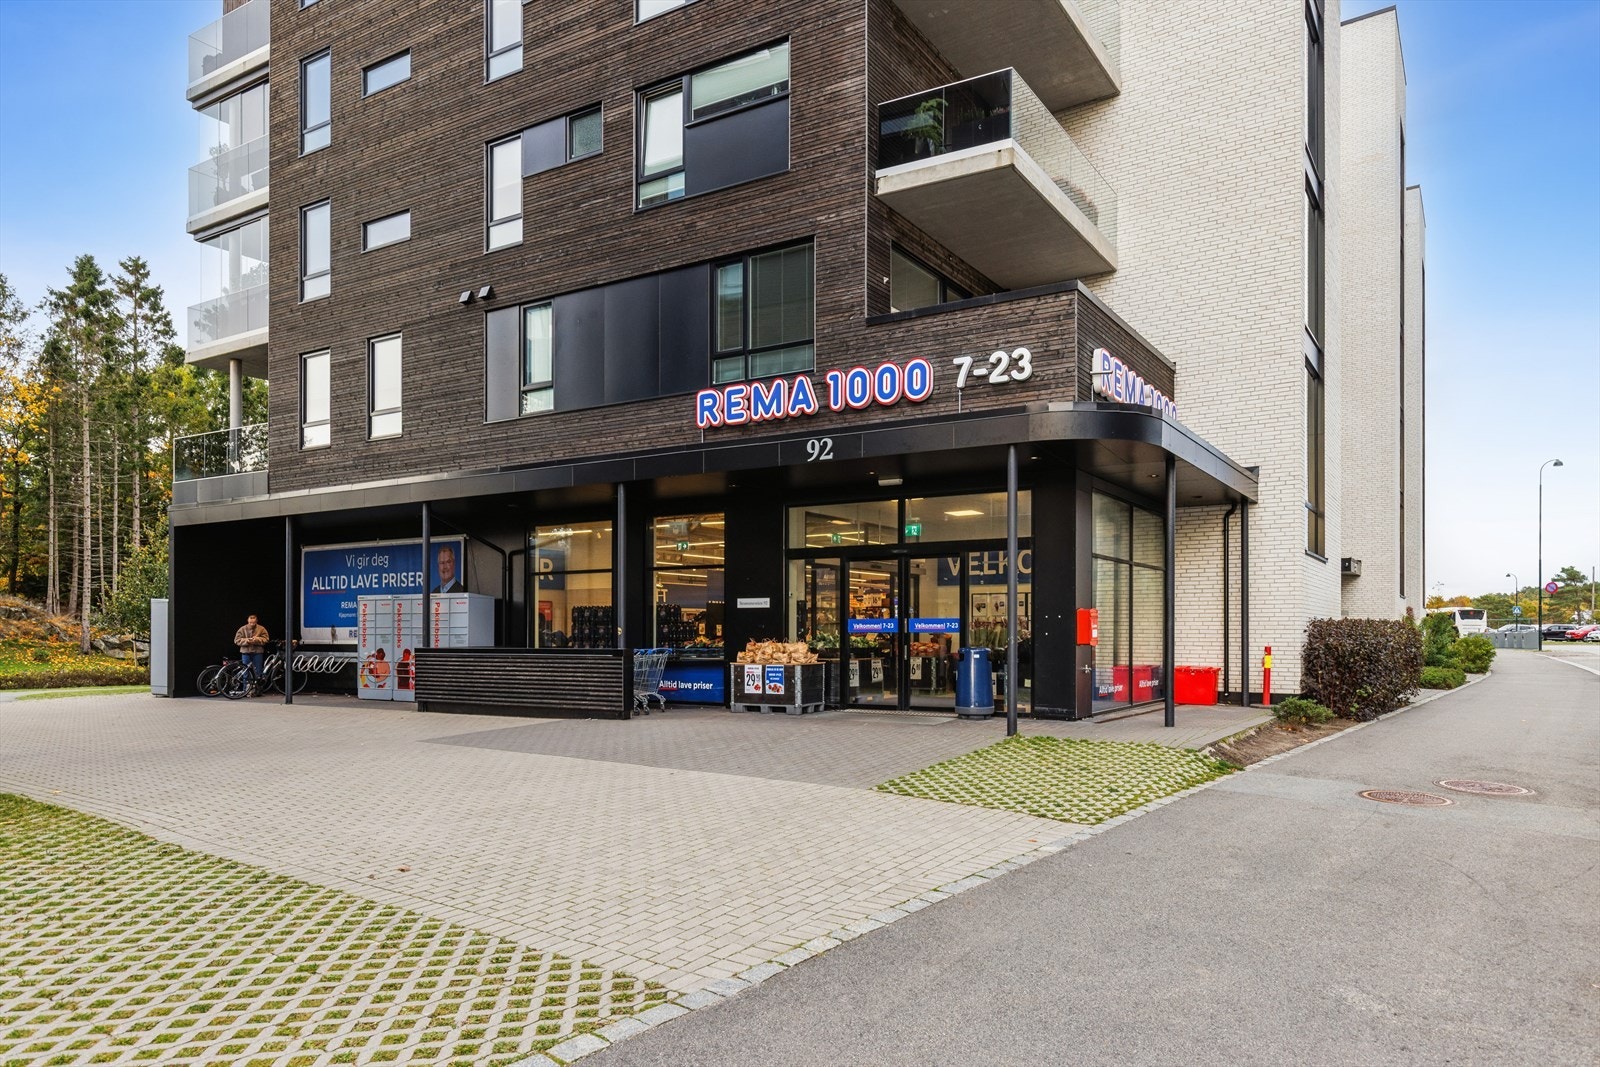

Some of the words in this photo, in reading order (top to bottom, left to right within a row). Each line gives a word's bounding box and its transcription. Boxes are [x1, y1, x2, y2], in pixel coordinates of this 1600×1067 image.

[952, 347, 1034, 389] 7-23
[1099, 348, 1146, 405] REMA
[696, 374, 819, 429] REMA
[825, 357, 934, 412] 1000
[806, 438, 834, 462] 92
[345, 554, 356, 568] Vi
[357, 554, 370, 570] gir
[371, 553, 389, 568] deg
[311, 575, 348, 591] ALLTID
[350, 573, 379, 589] LAVE
[382, 571, 424, 588] PRISER
[659, 680, 677, 689] Alltid
[678, 681, 692, 689] lave
[693, 681, 713, 690] priser
[746, 673, 756, 687] 29
